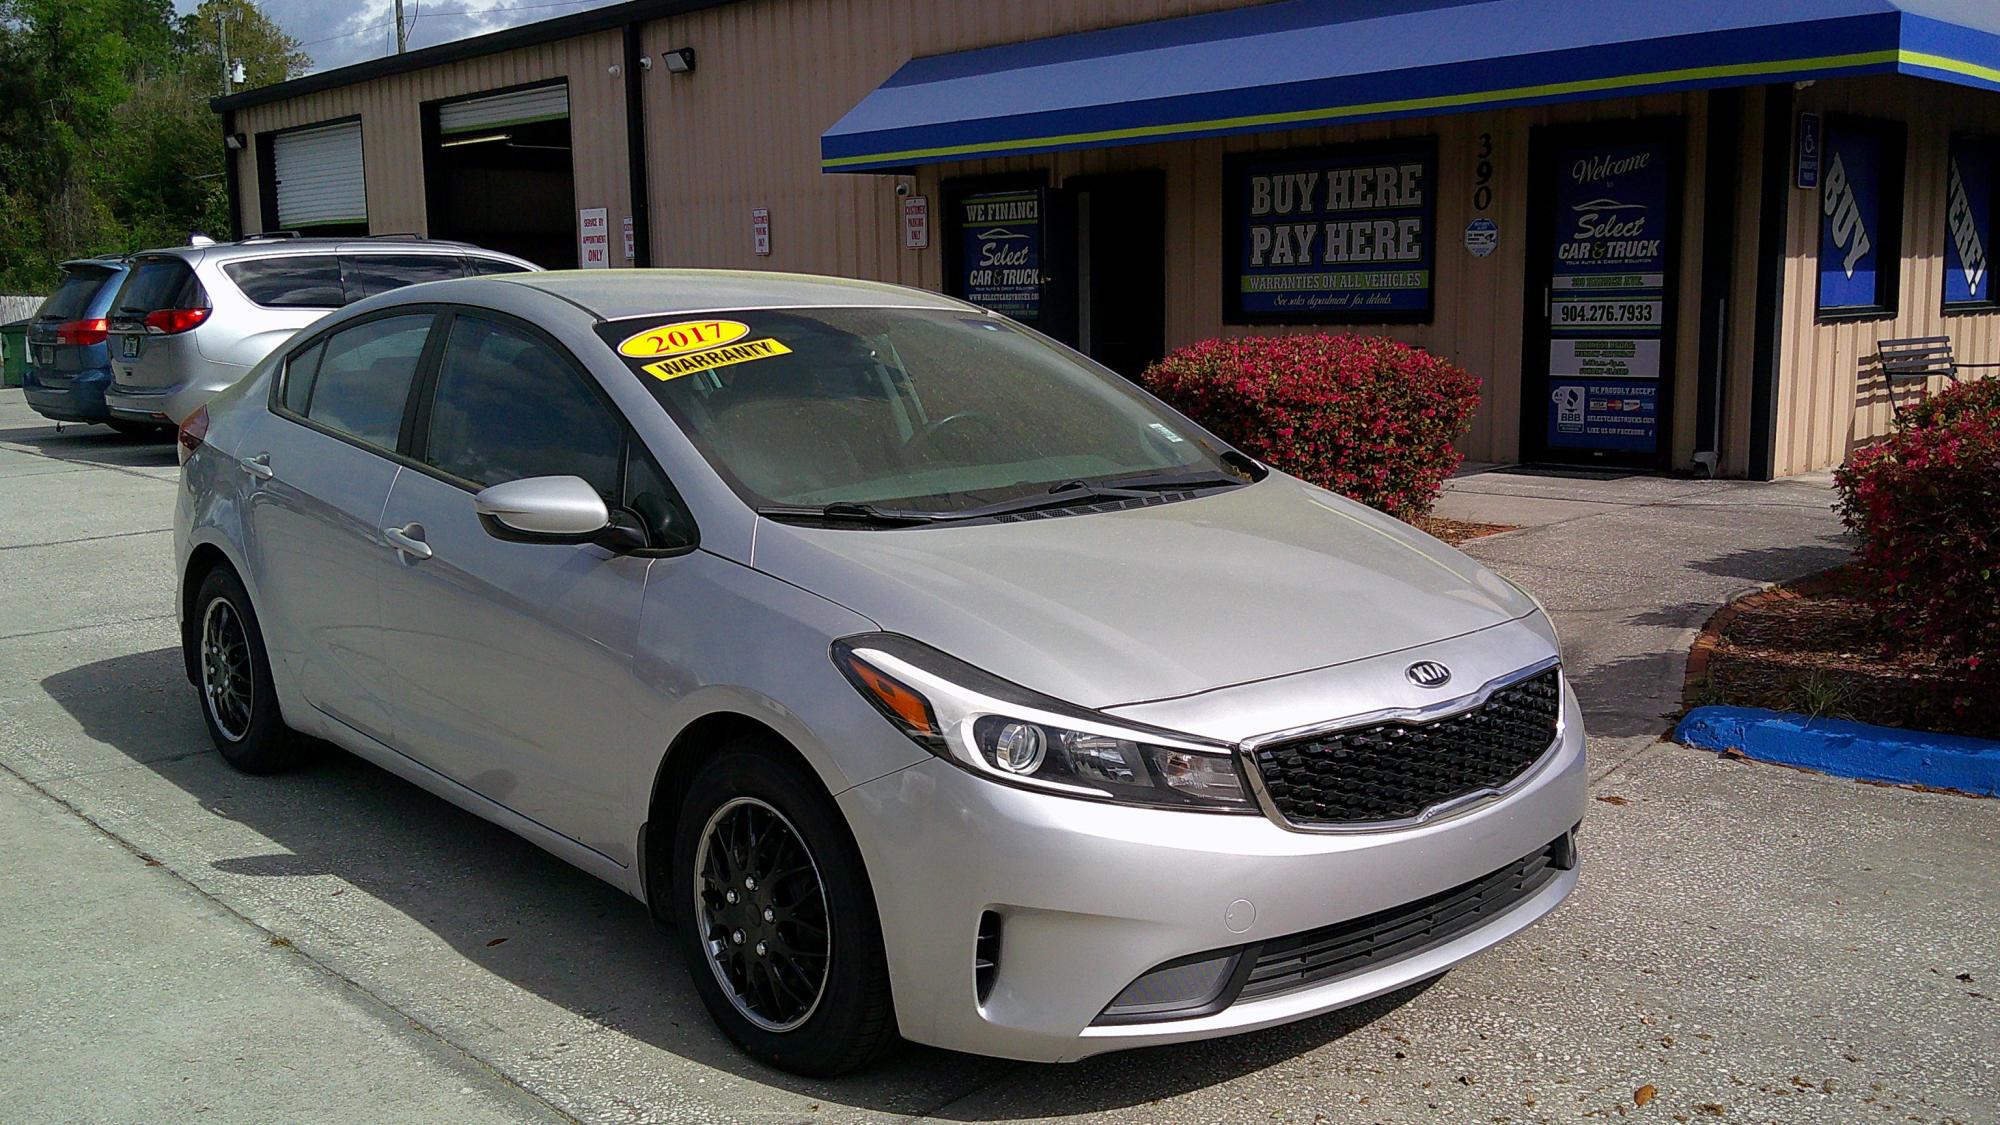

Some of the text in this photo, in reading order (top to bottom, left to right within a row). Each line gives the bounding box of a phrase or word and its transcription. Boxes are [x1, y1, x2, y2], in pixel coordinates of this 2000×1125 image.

[1474, 133, 1492, 211] 390
[1571, 151, 1651, 185] Welcome
[1251, 163, 1424, 215] BUY HERE
[966, 204, 985, 222] WE
[1825, 152, 1870, 280] BUY
[1573, 213, 1646, 240] Select
[1251, 224, 1318, 266] PAY
[1325, 217, 1422, 262] HERE
[1558, 240, 1660, 260] CAR & TRUCK
[588, 249, 604, 262] ONLY
[979, 242, 1030, 268] Select
[969, 269, 993, 286] CAR
[1003, 268, 1040, 285] TRUCK
[1250, 272, 1421, 290] WARRANTIES ON ALL VEHICLES
[1561, 304, 1653, 322] 904.276.7933
[647, 322, 722, 354] 2017
[655, 340, 775, 377] WARRANTY
[1561, 412, 1581, 422] BBB
[1411, 663, 1448, 683] KIA
